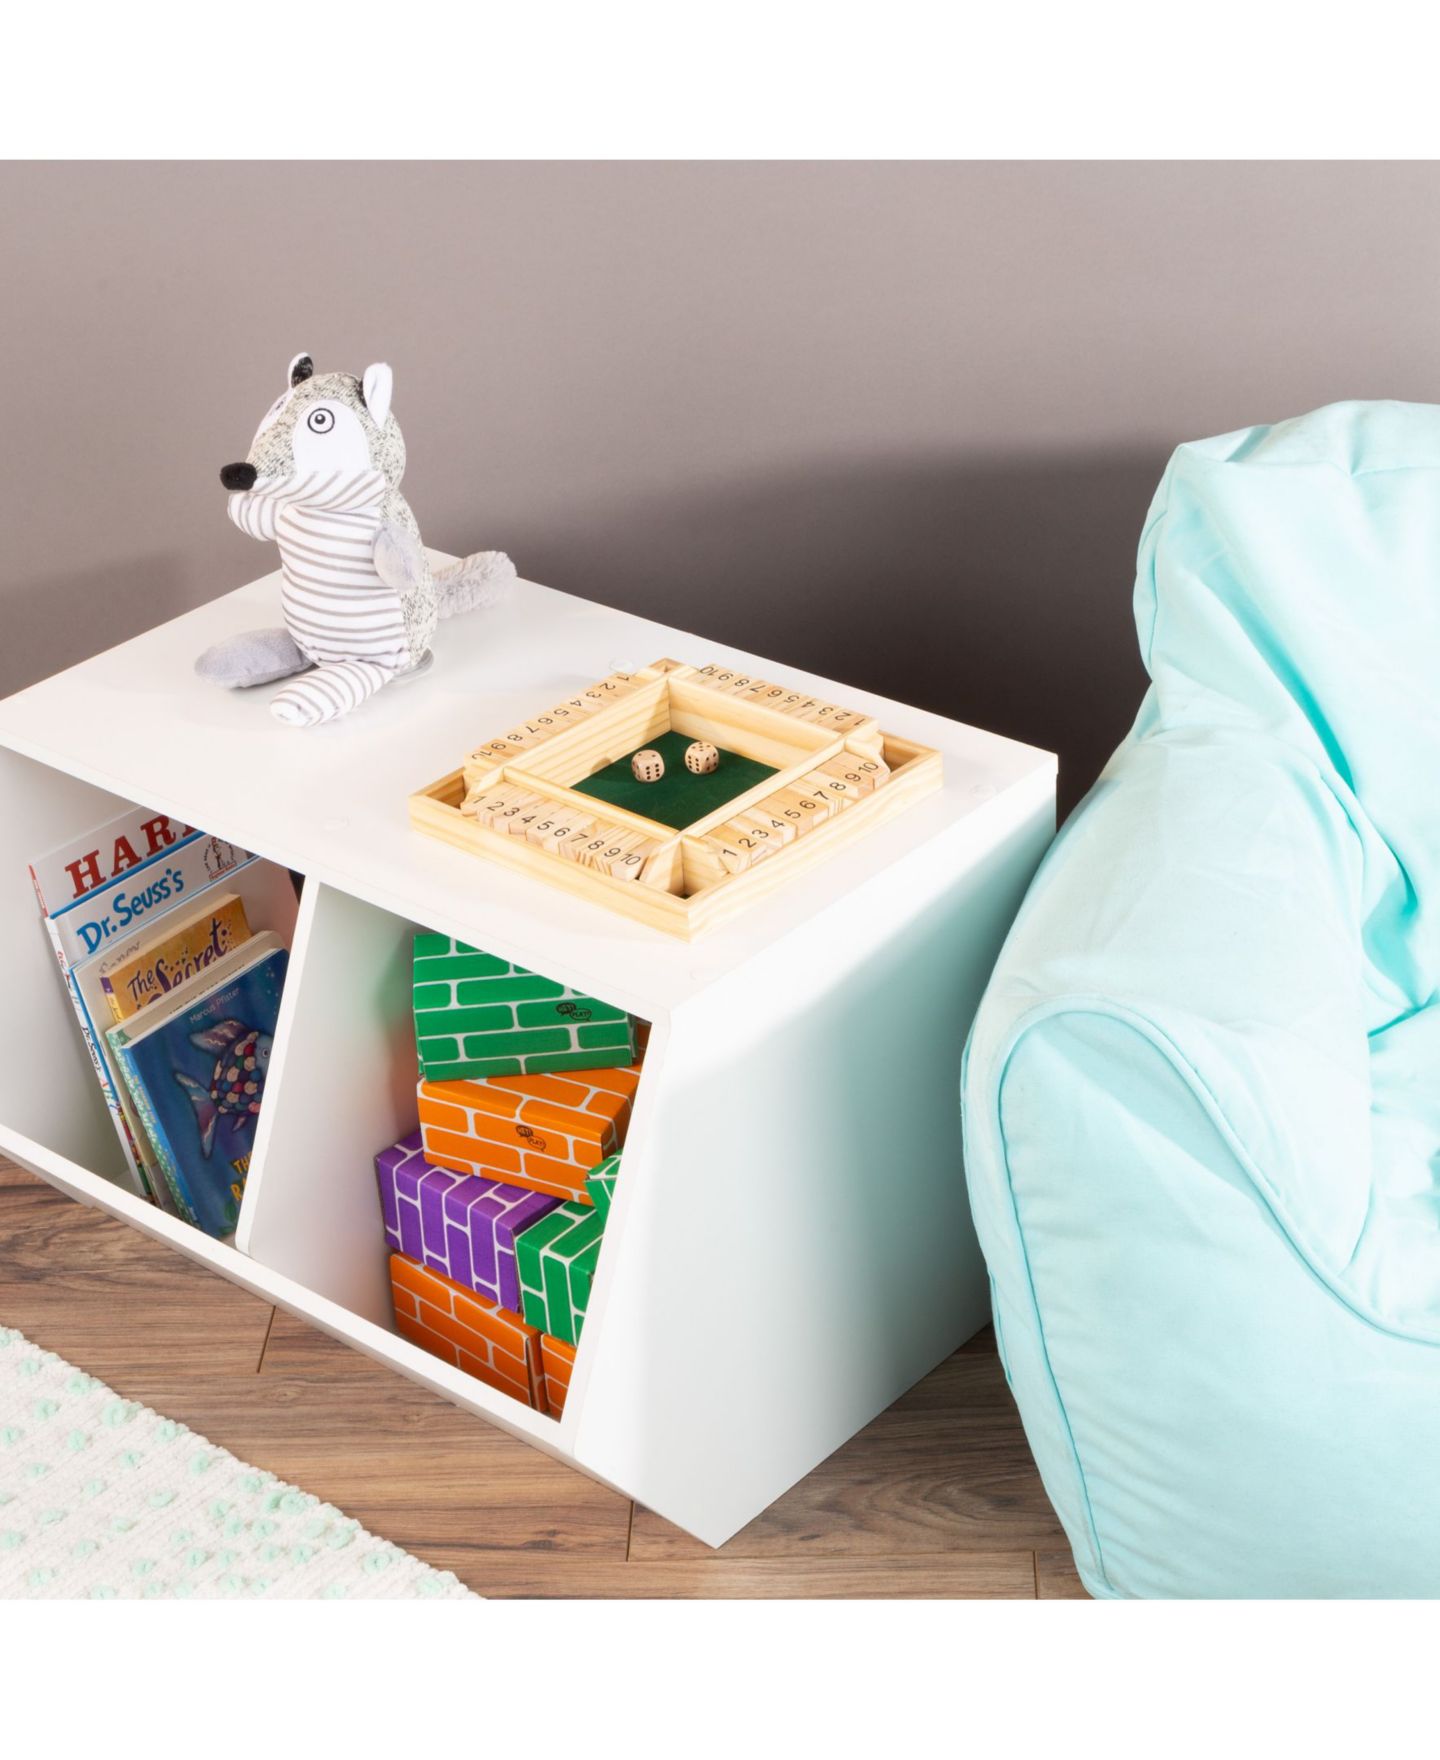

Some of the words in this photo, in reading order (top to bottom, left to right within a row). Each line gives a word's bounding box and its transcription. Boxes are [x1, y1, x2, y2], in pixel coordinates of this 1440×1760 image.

[699, 666, 719, 677] 10
[718, 672, 734, 681] 9
[599, 682, 616, 691] 2
[734, 678, 750, 687] 8
[749, 684, 766, 693] 7
[585, 690, 601, 699] 3
[767, 689, 782, 698] 6
[569, 699, 582, 708] 4
[783, 694, 800, 704] 5
[801, 700, 816, 709] 4
[554, 708, 570, 717] 5
[818, 706, 834, 716] 3
[834, 711, 852, 721] 2
[537, 717, 554, 725] 6
[853, 718, 866, 727] 1
[526, 725, 540, 734] 7
[507, 734, 523, 742] 8
[491, 742, 507, 750] 9
[722, 848, 738, 858] 1
[738, 838, 757, 849] 2
[751, 829, 769, 839] 3
[770, 819, 786, 829] 4
[783, 809, 801, 819] 5
[799, 800, 816, 810] 6
[812, 790, 830, 801] 7
[829, 781, 847, 791] 8
[844, 772, 862, 782] 9
[858, 762, 879, 774] 10
[472, 795, 487, 805] 1
[486, 801, 505, 812] 2
[503, 807, 520, 818] 3
[521, 815, 537, 824] 4
[536, 820, 555, 831] 5
[553, 827, 571, 838] 6
[570, 833, 589, 844] 7
[587, 839, 605, 850] 8
[603, 847, 621, 858] 9
[619, 853, 641, 866] 10
[64, 814, 199, 899] HAR
[76, 918, 118, 954] Dr.
[112, 868, 184, 927] Seuss's
[155, 918, 228, 993] Secret
[126, 966, 156, 1001] The
[190, 1004, 216, 1023] Marcus
